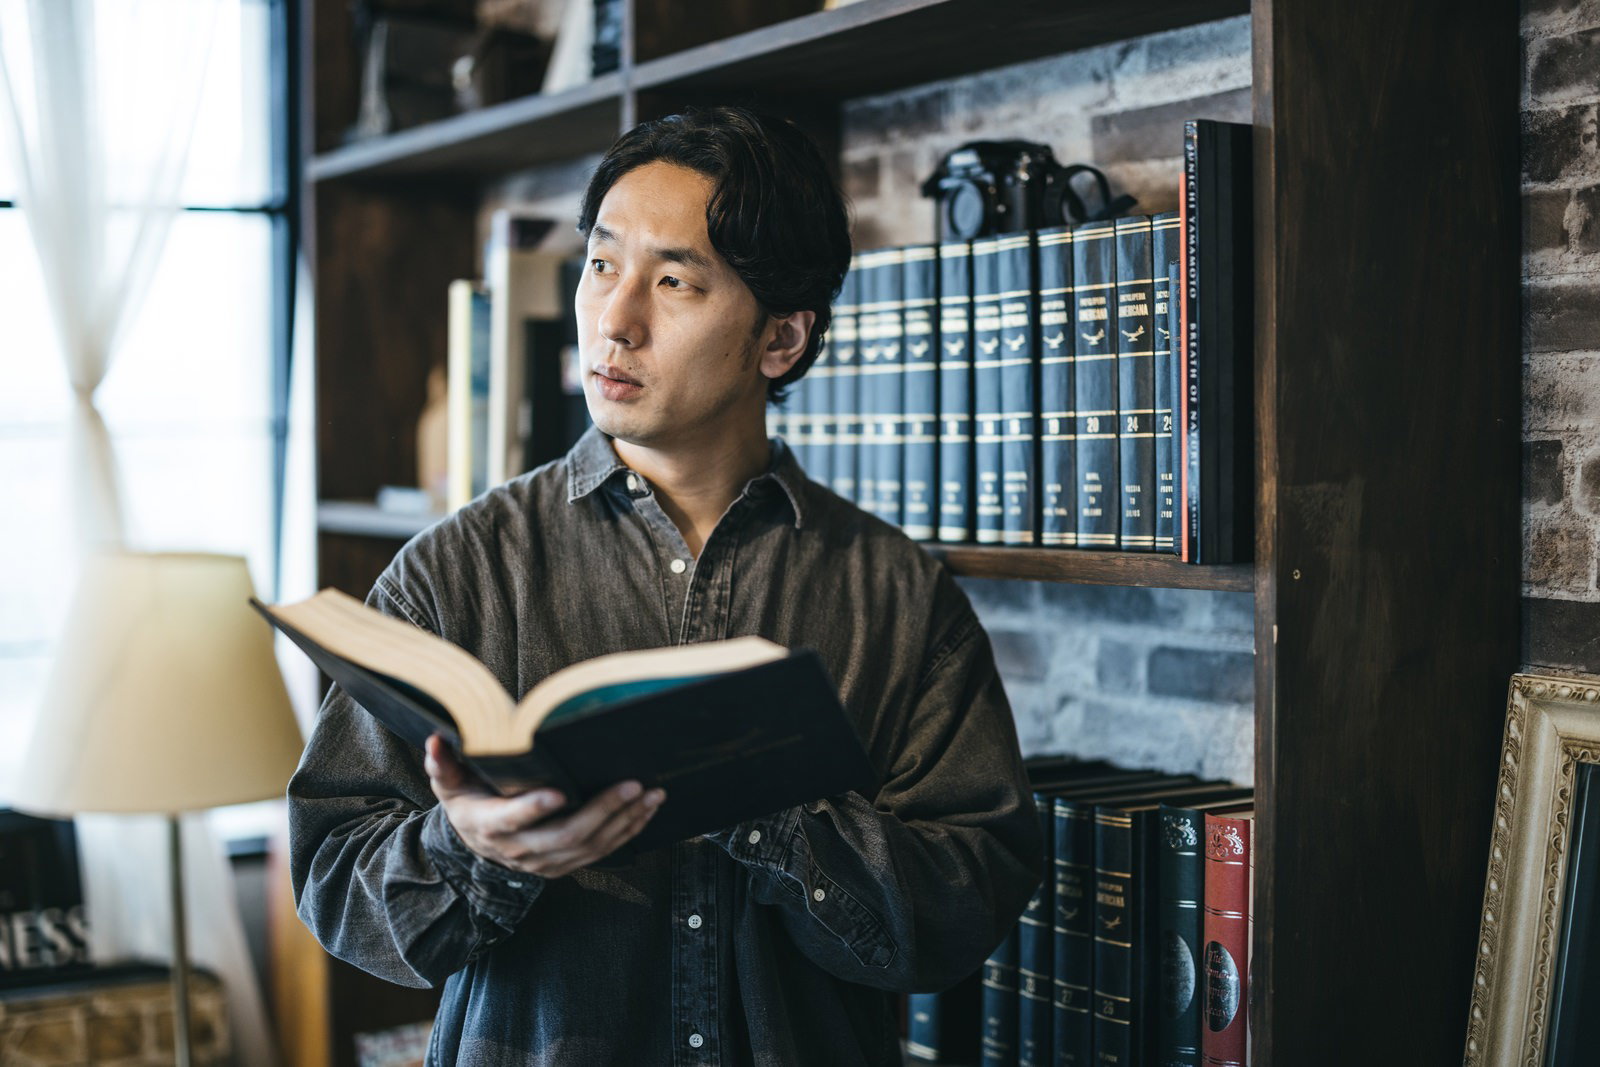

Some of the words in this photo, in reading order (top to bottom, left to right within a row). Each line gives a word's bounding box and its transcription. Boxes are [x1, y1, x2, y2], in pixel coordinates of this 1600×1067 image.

[1187, 144, 1196, 209] JUNICHI
[1188, 216, 1197, 299] YAMAMOTO
[1118, 303, 1149, 318] AMERICANA
[1189, 323, 1197, 378] BREATH
[1190, 385, 1198, 403] OF
[1086, 417, 1099, 433] 20
[1127, 416, 1139, 432] 24
[1190, 411, 1198, 466] NATURE
